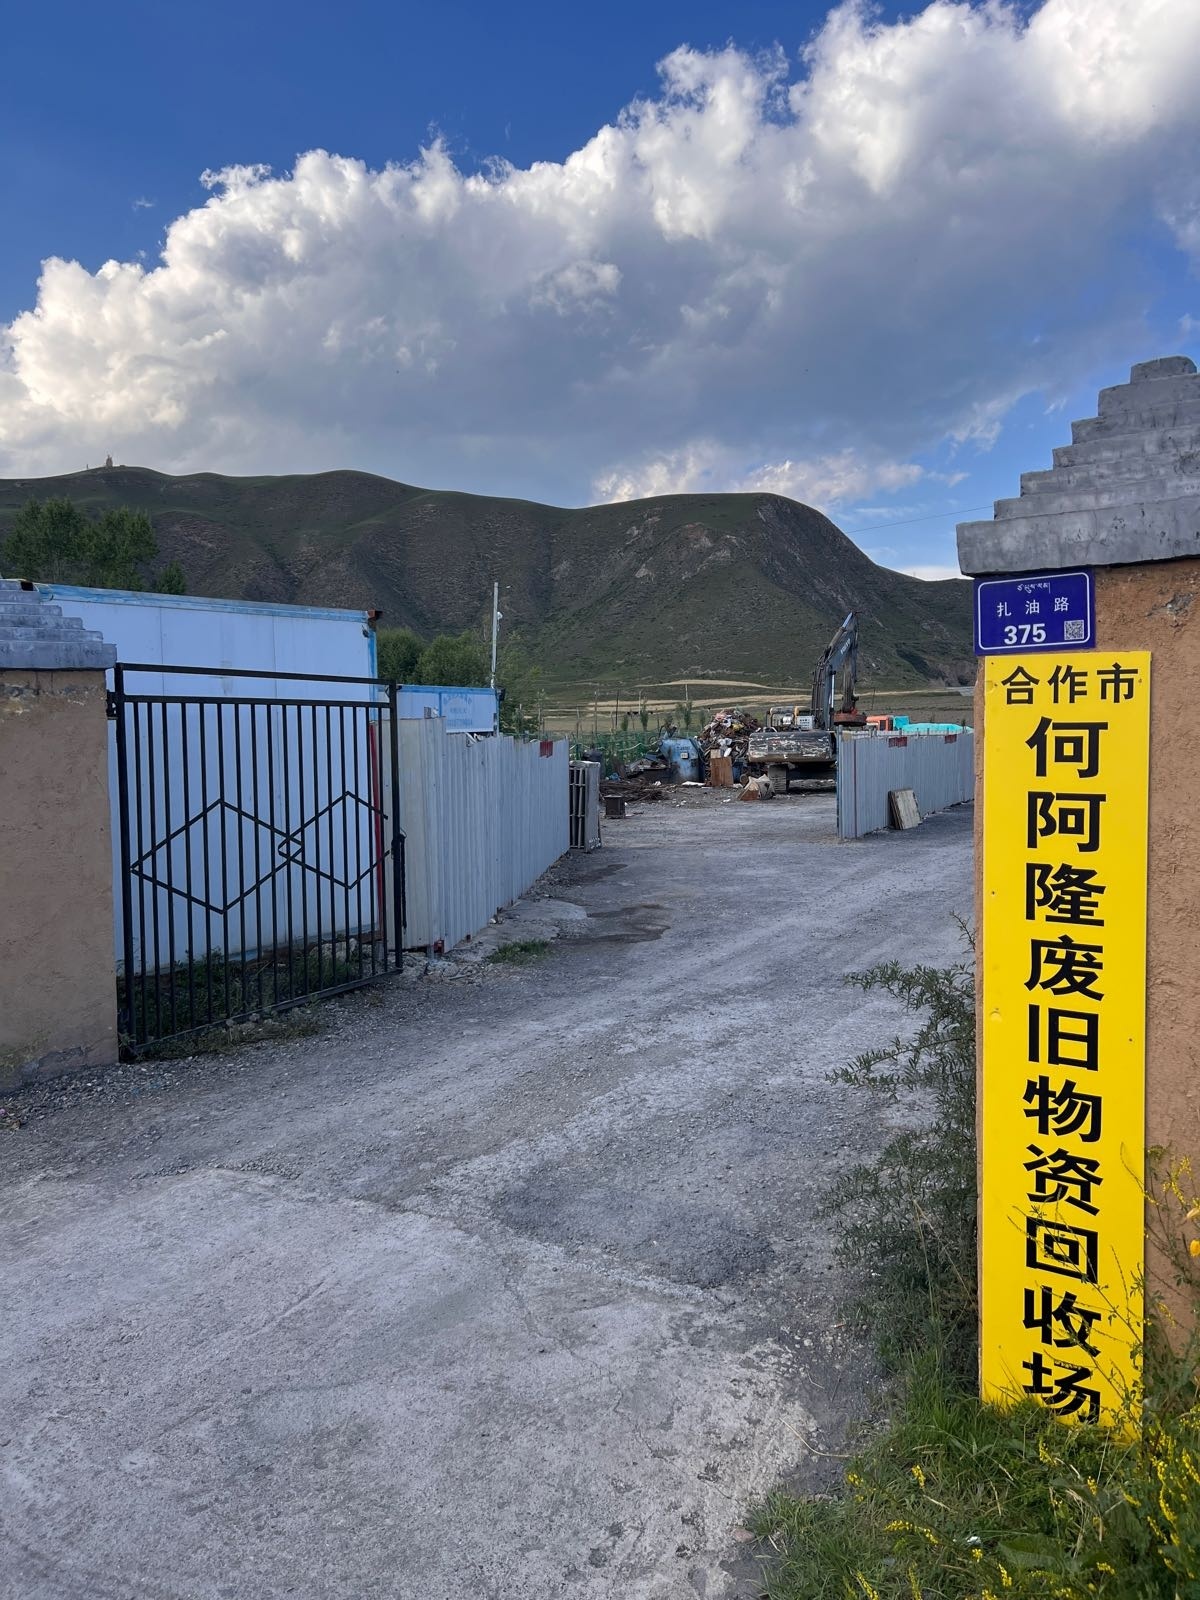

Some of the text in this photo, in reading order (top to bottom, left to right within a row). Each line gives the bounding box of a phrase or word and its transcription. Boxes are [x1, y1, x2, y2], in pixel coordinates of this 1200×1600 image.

[996, 596, 1070, 617] 扎油路
[1003, 623, 1047, 645] 375
[1001, 662, 1139, 705] 合作市
[1021, 716, 1109, 1424] 何阿隆废旧物资回收场
